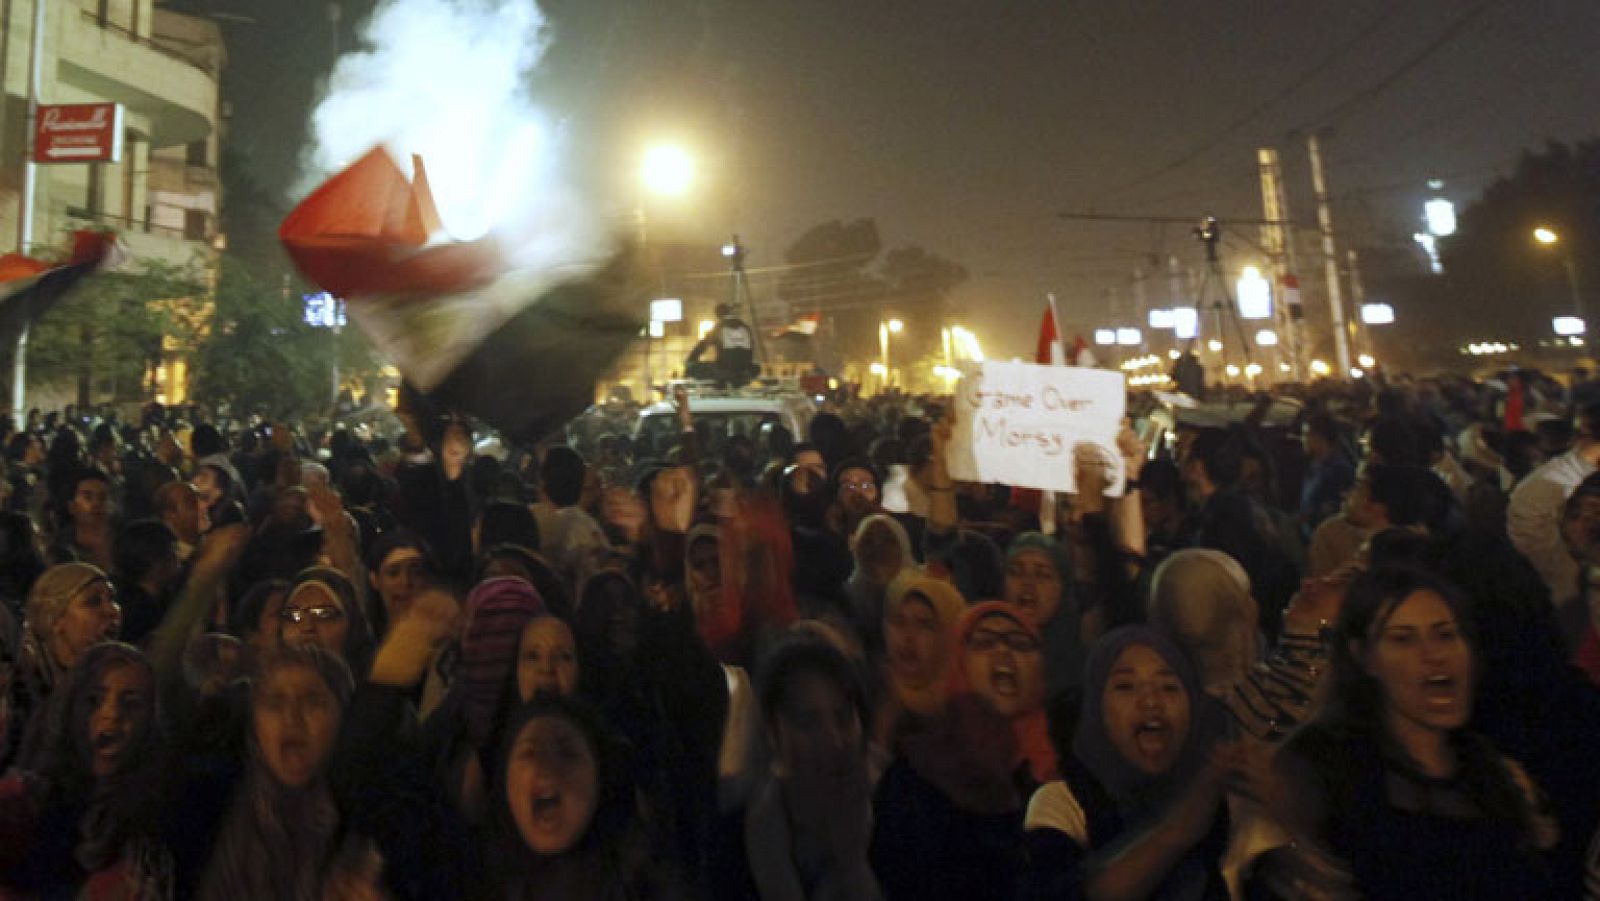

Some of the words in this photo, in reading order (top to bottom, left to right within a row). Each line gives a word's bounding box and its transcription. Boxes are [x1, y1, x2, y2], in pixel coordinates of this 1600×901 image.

[968, 373, 1034, 410] Game
[1042, 384, 1094, 411] Over
[977, 416, 1063, 455] Morsy
